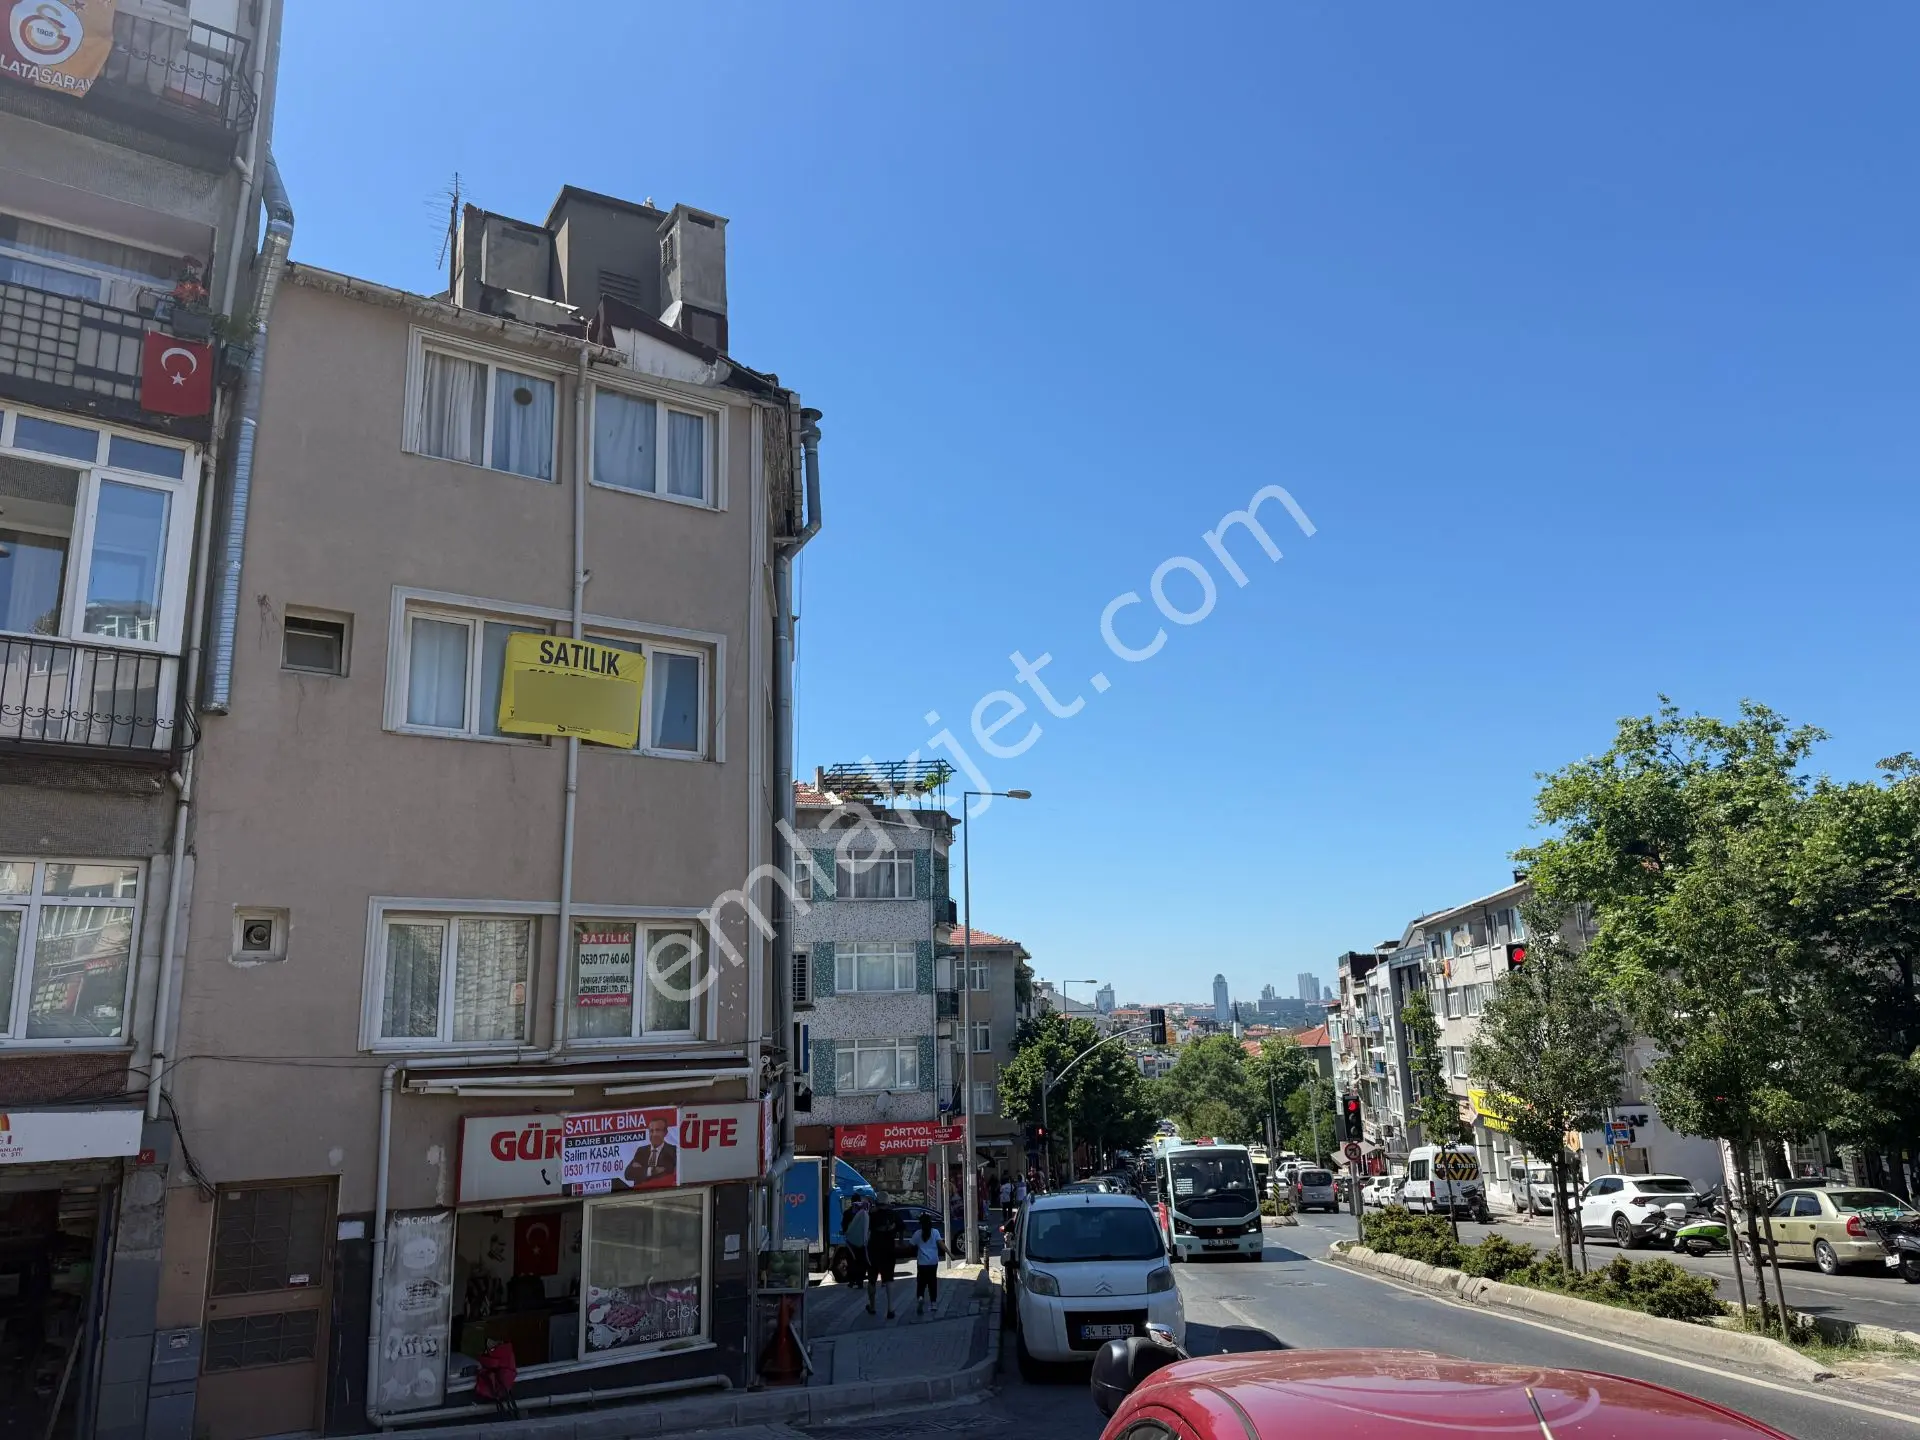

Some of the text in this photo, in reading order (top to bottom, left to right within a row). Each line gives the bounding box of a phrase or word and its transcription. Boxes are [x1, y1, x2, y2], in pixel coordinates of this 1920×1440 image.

[539, 639, 620, 676] SATILIK
[582, 933, 630, 943] SATILIK
[581, 952, 630, 965] 0530 177 60 60
[565, 1111, 647, 1134] SATILIK BİNA
[884, 1126, 931, 1137] DÖRTYOL
[575, 1137, 601, 1146] DAİRE
[609, 1133, 644, 1143] DÜKKAN
[564, 1145, 620, 1163] Salim KASAR
[564, 1160, 624, 1177] 0530 177 60 60
[1085, 1325, 1132, 1336] 34 FE 152
